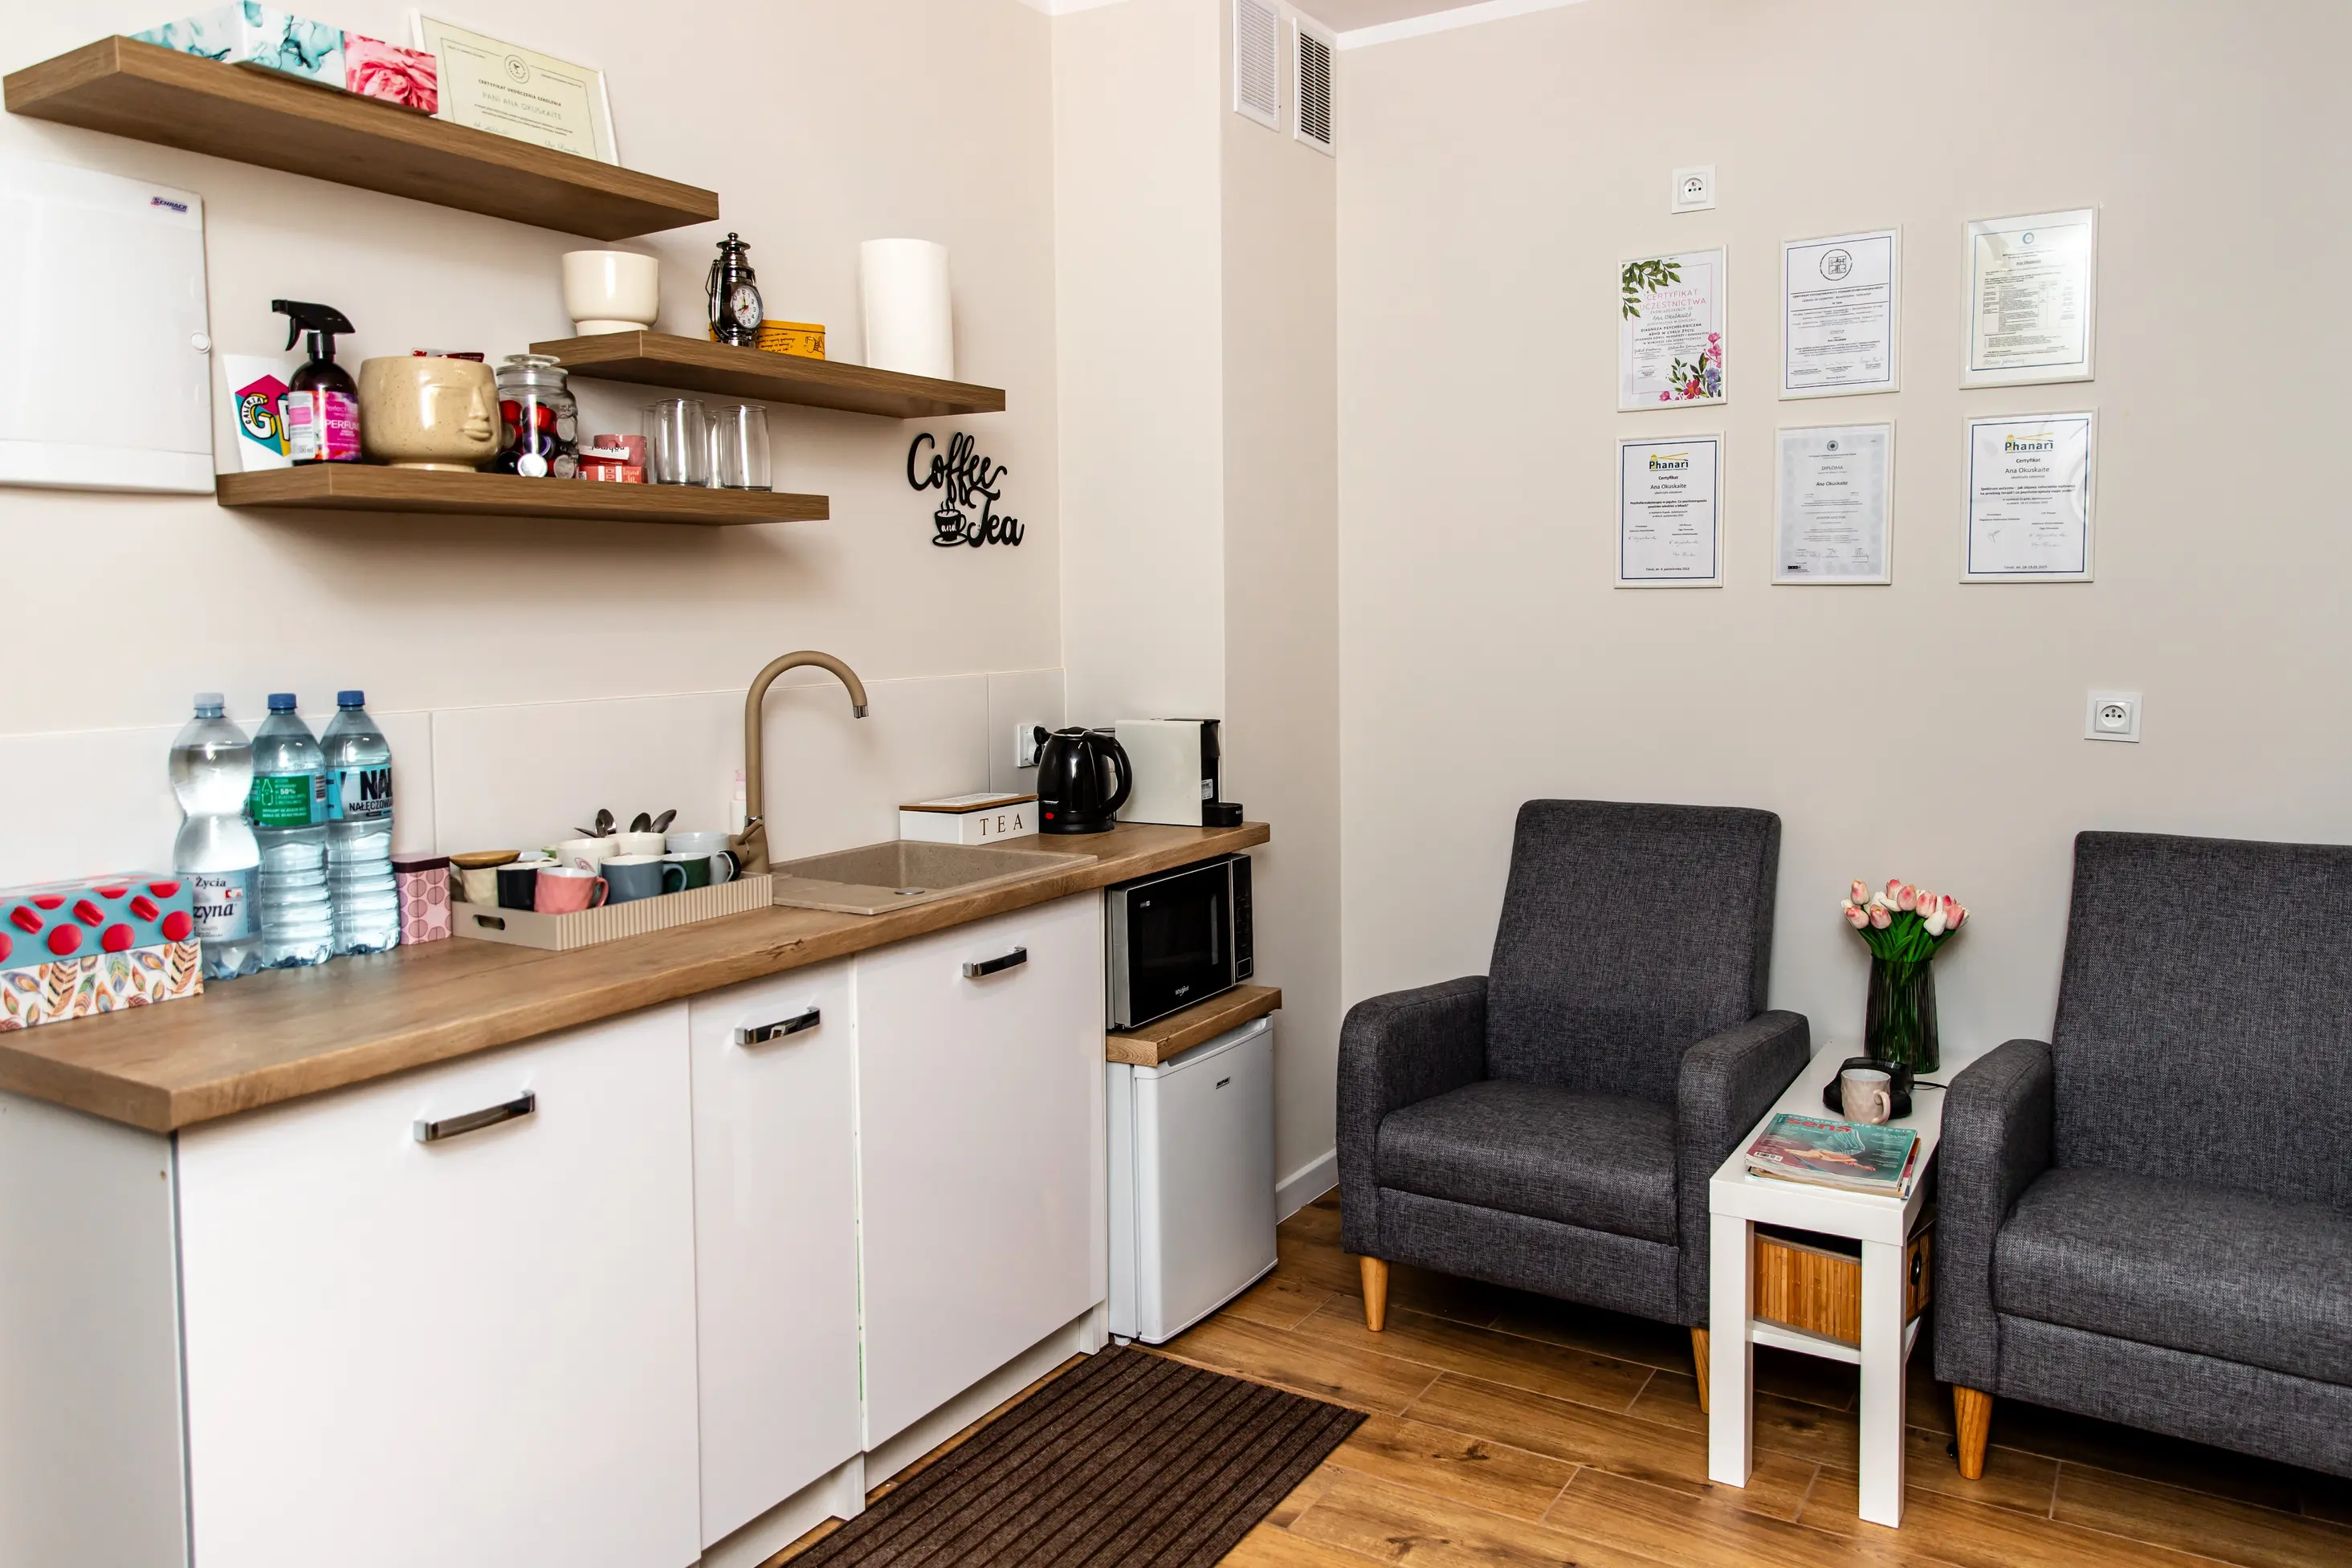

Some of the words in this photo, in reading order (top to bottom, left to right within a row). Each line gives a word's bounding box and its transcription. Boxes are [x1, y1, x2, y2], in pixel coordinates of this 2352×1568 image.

[478, 79, 506, 90] CERTYFIKAT
[537, 96, 561, 107] SZKOLENIA
[1639, 298, 1706, 311] UCZESTNICTWA
[1646, 289, 1698, 301] CERTYFIKAT
[907, 432, 1008, 506] Coffee
[940, 519, 957, 532] and
[967, 486, 1025, 548] Tea
[979, 813, 1023, 836] TEA
[195, 875, 226, 890] Życia
[193, 902, 234, 924] zyna
[1786, 1117, 1852, 1133] sens
